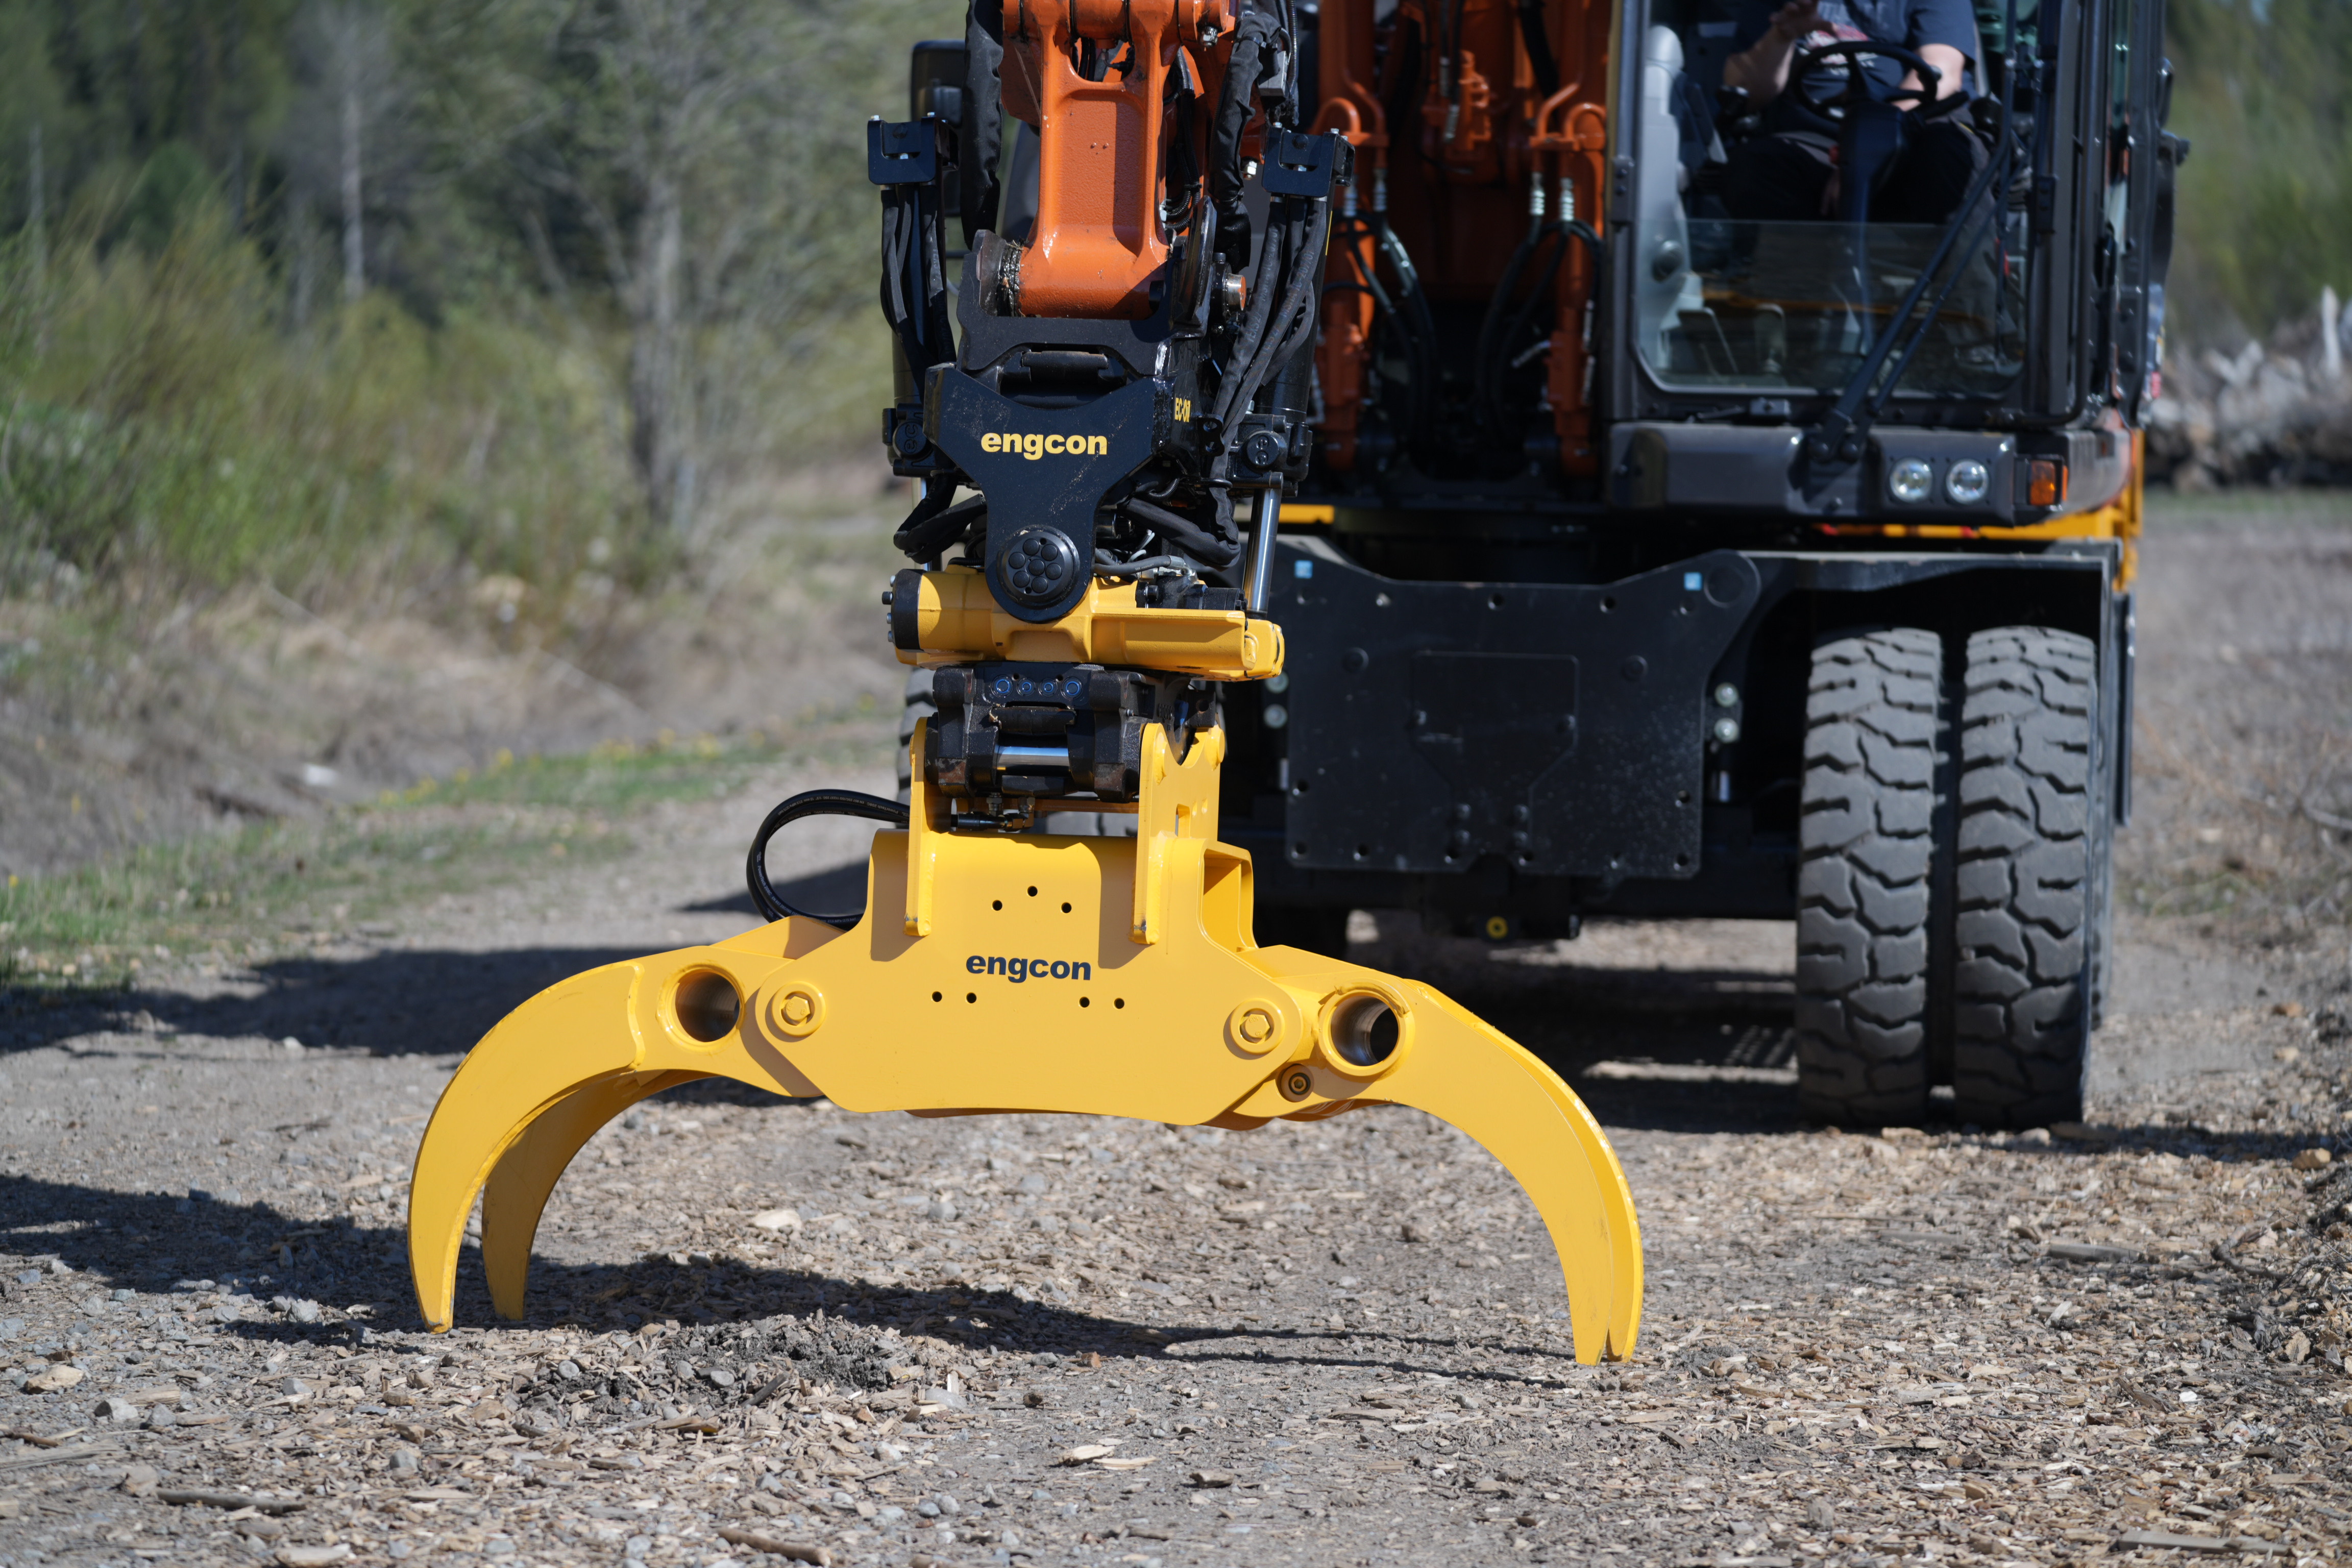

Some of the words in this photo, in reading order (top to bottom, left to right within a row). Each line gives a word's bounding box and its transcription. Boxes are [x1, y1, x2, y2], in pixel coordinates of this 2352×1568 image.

[1175, 397, 1191, 423] EC-Oil
[981, 433, 1107, 460] engcon
[877, 804, 899, 814] PowerTech
[757, 865, 766, 886] PowerTech
[966, 955, 1091, 983] engcon
